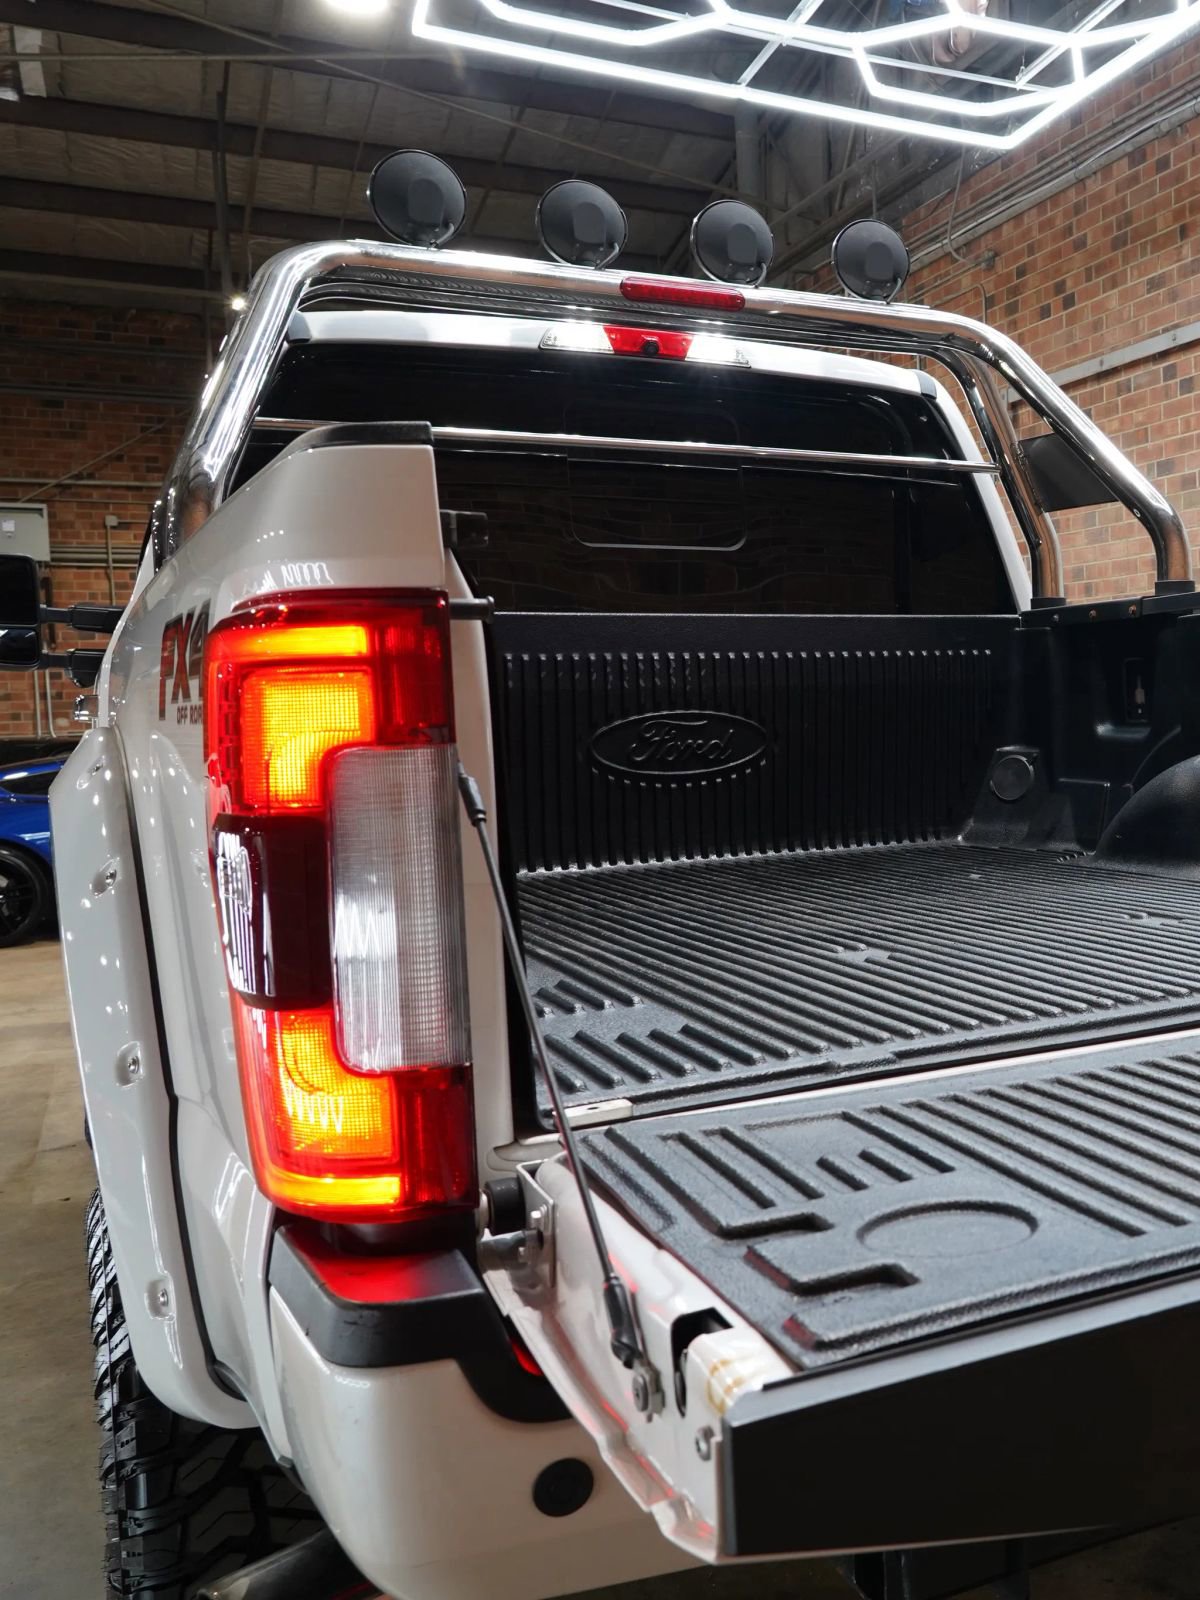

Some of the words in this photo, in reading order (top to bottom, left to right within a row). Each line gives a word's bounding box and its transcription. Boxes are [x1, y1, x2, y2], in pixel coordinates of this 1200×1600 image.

[158, 598, 212, 721] FX4
[177, 705, 188, 725] OFF
[189, 704, 203, 725] ROA
[629, 719, 734, 762] Ford
